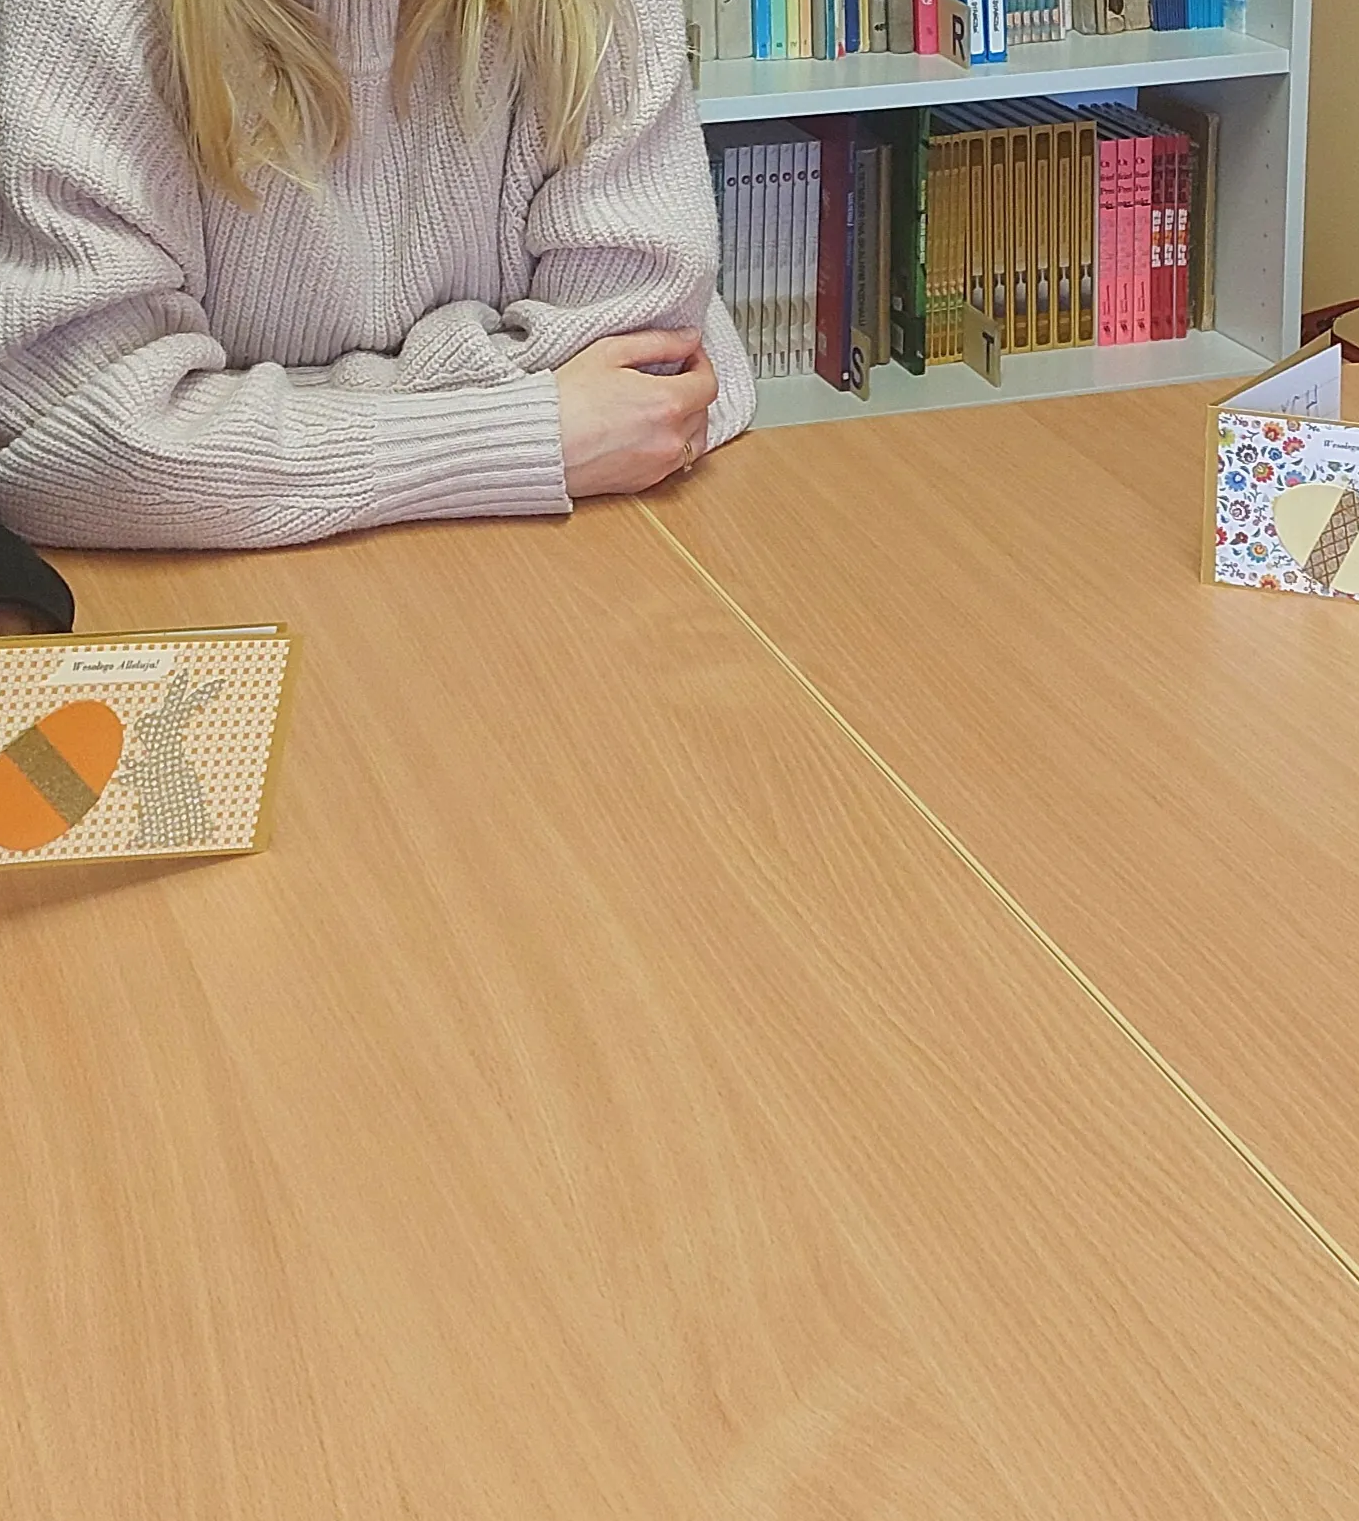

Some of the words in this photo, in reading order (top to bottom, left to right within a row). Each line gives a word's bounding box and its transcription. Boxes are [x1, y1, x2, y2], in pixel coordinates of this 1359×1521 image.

[952, 14, 965, 61] R
[72, 661, 115, 672] Wesołego
[118, 659, 160, 672] Alleluja!
